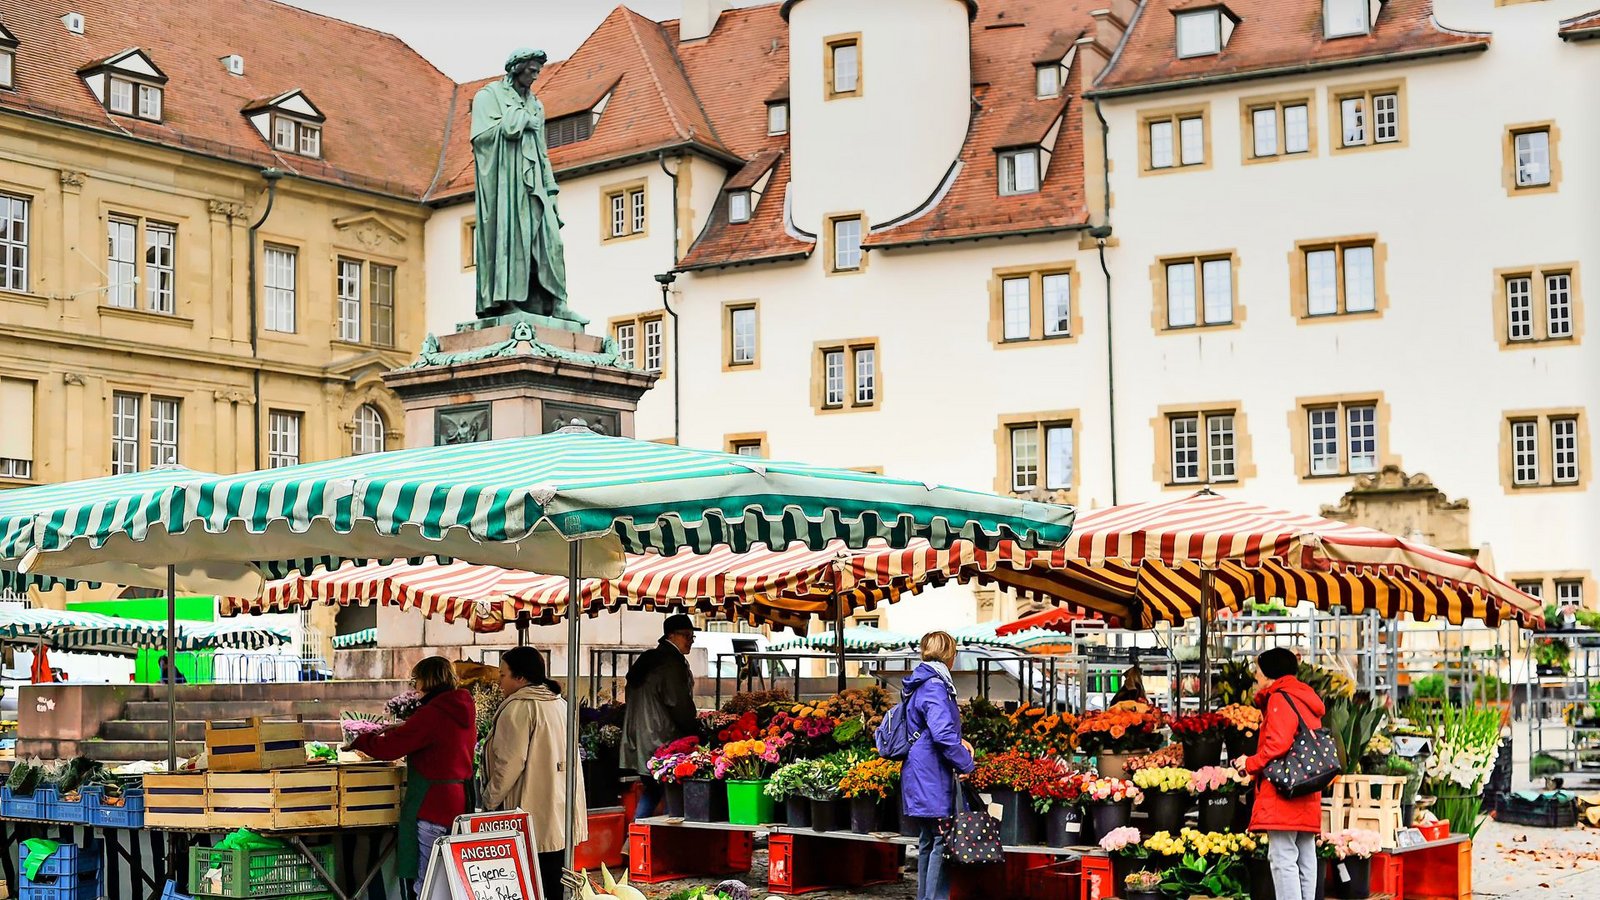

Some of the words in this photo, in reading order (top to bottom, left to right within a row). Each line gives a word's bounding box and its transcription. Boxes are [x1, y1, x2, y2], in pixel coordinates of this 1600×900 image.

[479, 818, 522, 833] ANGEBOT
[461, 844, 511, 860] ANGEBOT
[468, 864, 508, 889] Eigene
